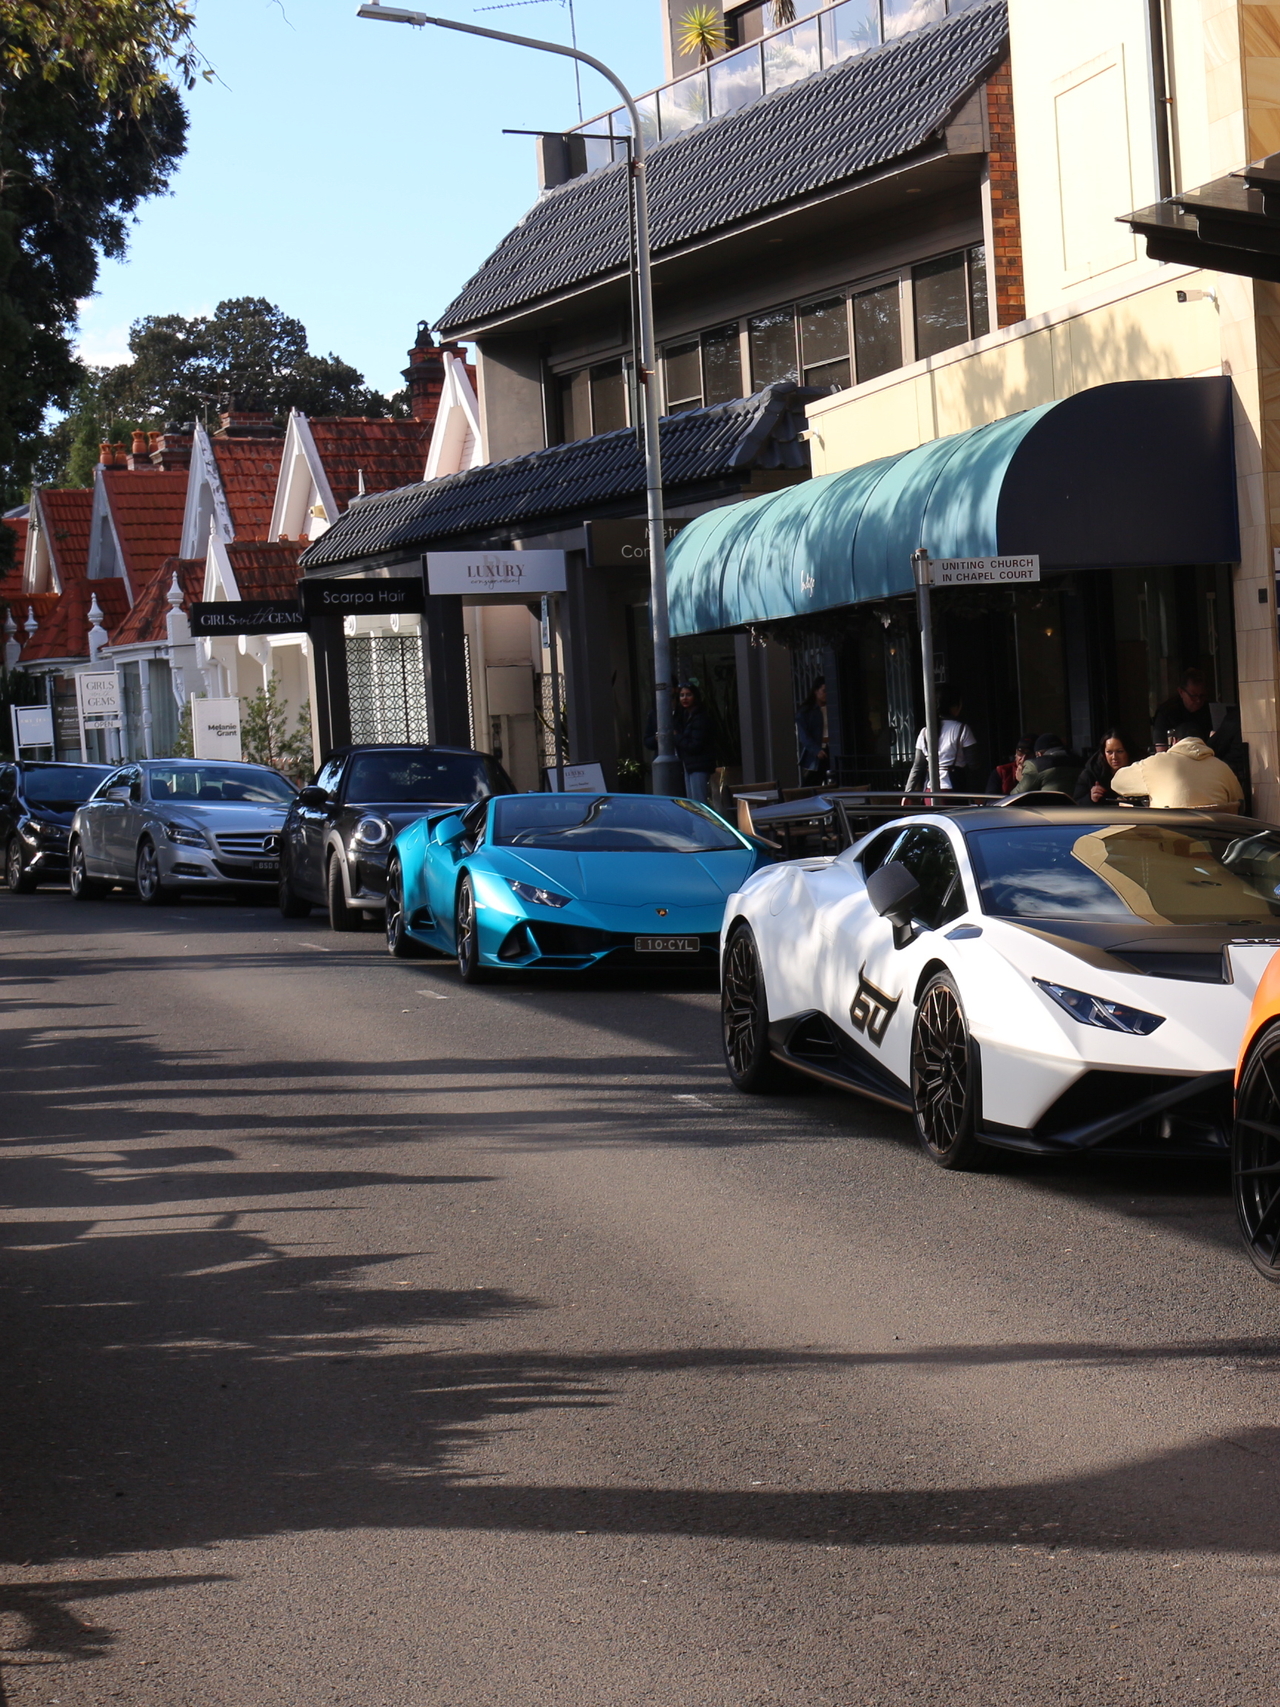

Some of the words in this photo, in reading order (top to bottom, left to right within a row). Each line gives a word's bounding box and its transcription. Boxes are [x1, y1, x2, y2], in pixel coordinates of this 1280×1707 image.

[467, 563, 527, 578] LUXURY
[941, 560, 985, 571] UNITING
[990, 558, 1034, 569] CHURCH
[942, 573, 952, 582] IN
[956, 571, 995, 582] CHAPEL
[999, 569, 1034, 580] COURT
[323, 590, 374, 605] Scarpa
[378, 589, 406, 602] Hair
[200, 614, 236, 626] GIRLS
[236, 606, 274, 626] with
[268, 612, 303, 624] GEMS
[86, 680, 115, 691] GIRLS
[87, 697, 116, 707] GEMS
[208, 723, 237, 731] Melanie
